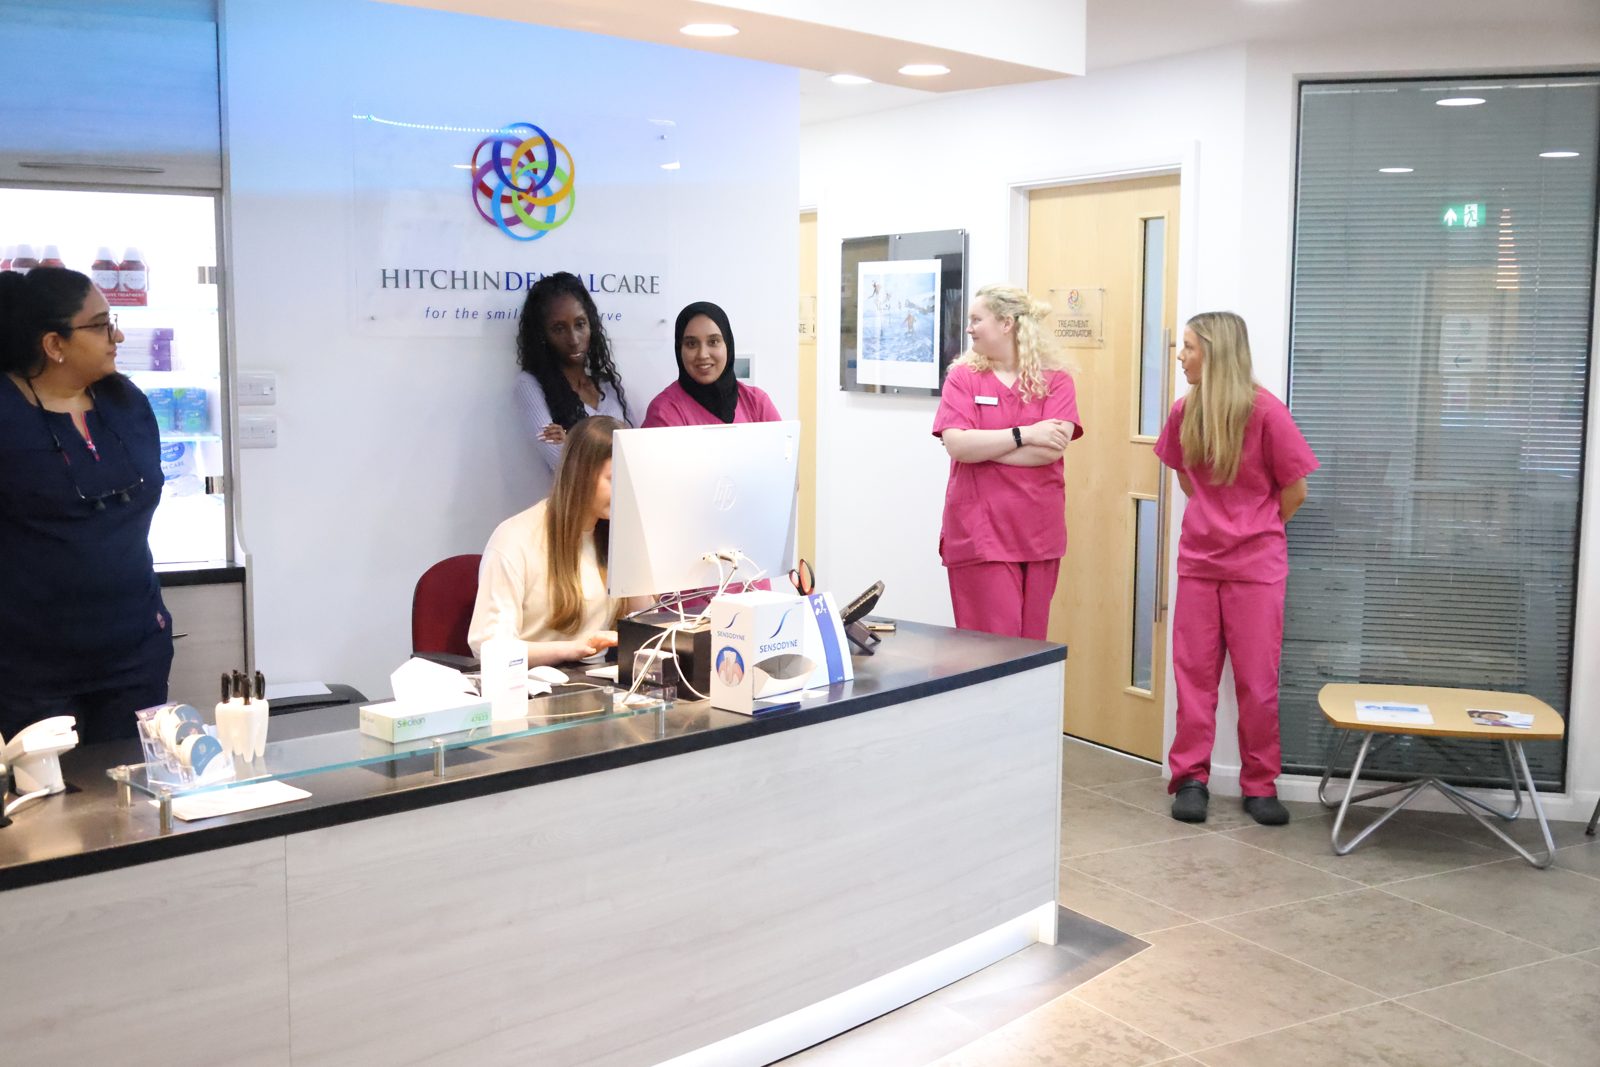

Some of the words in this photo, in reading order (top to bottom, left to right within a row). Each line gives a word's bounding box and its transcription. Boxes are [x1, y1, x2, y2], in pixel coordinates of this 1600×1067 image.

[425, 306, 447, 319] for
[455, 307, 479, 319] the
[487, 308, 518, 320] smil
[1057, 319, 1089, 328] TREATMENT
[1054, 329, 1092, 337] COORDINATOR
[717, 631, 745, 641] SENSODYNE
[760, 640, 798, 654] SENSODYNE
